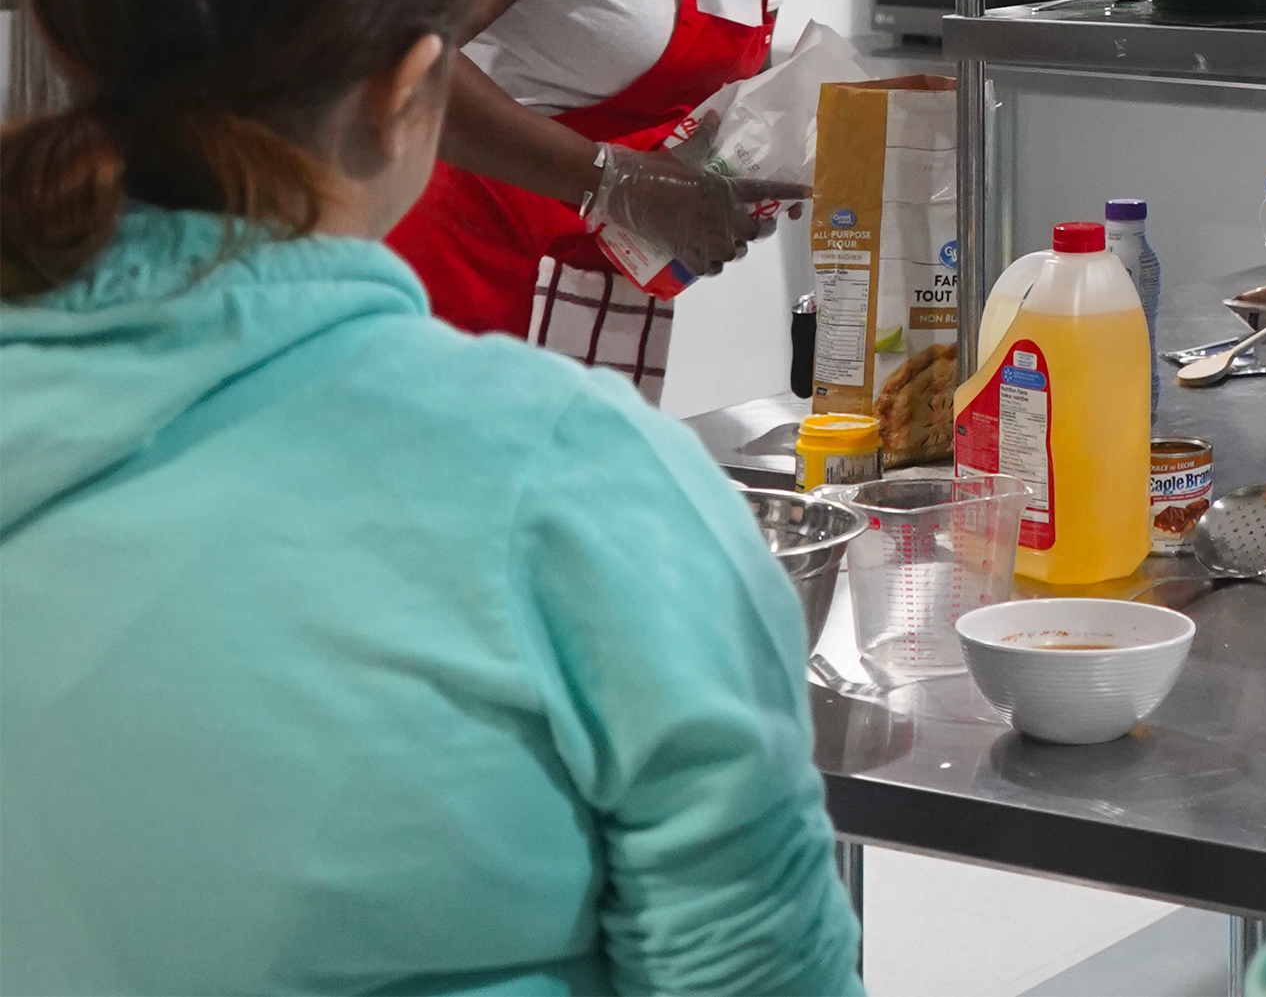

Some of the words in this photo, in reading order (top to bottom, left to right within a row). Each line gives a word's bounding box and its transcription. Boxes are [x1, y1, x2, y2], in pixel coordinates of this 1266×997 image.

[813, 230, 872, 240] ALL-PURPOSE
[827, 239, 858, 249] FLOUR
[915, 289, 953, 302] TOUT
[919, 314, 943, 323] NON
[1150, 475, 1184, 495] Eagle
